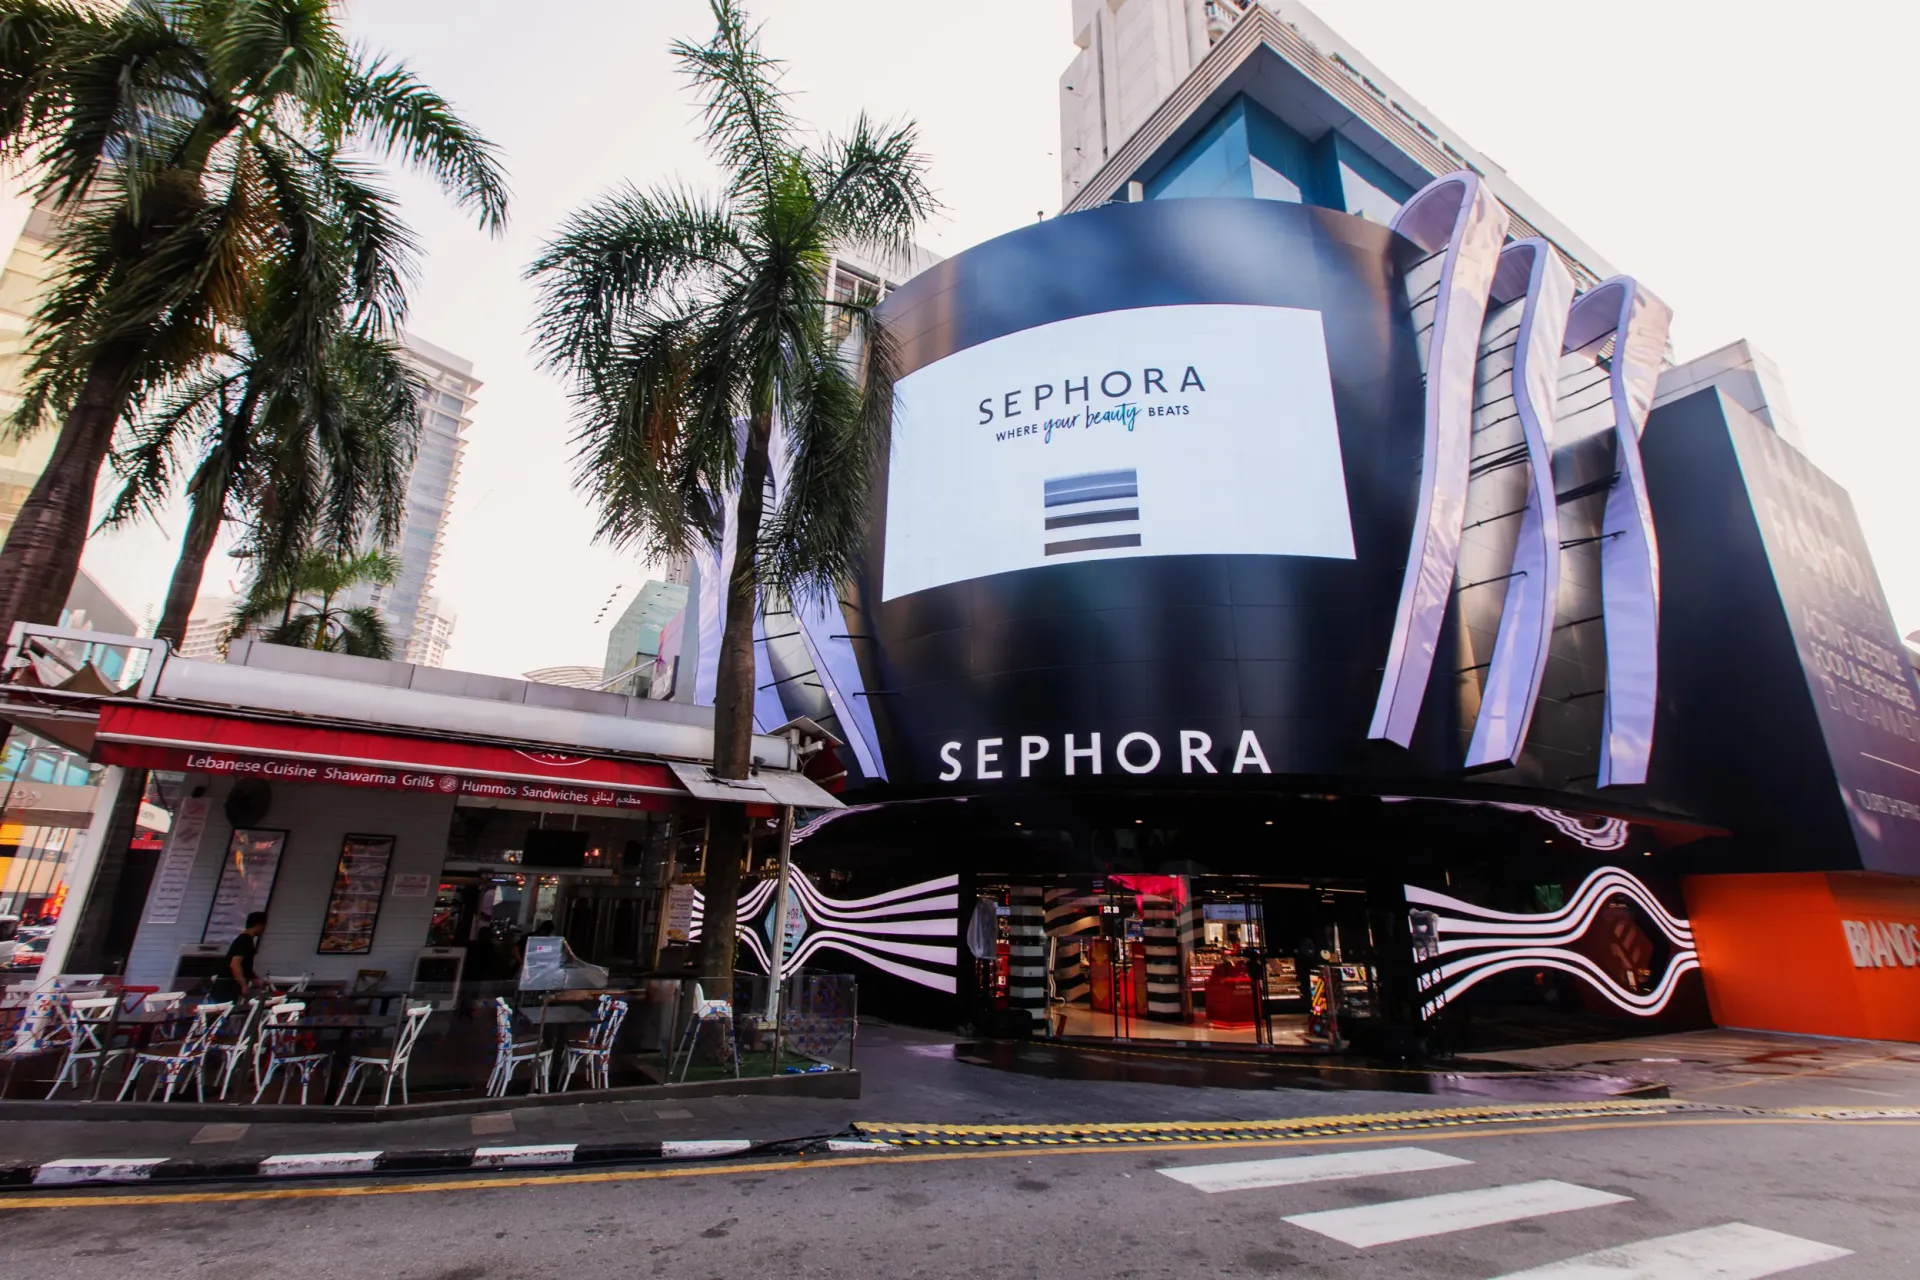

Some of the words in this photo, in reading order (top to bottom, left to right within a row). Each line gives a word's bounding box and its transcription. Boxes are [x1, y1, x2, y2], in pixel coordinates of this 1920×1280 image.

[979, 365, 1206, 425] SEPHORA
[995, 423, 1038, 442] WHERE
[1043, 413, 1081, 444] your
[1085, 402, 1142, 432] beauty
[1148, 405, 1190, 417] BEATS
[1764, 497, 1882, 612] FASHION
[1809, 641, 1850, 681] FOOD
[939, 730, 1272, 781] SEPHORA
[186, 755, 261, 772] Lebanese
[263, 762, 317, 777] Cuisine
[324, 767, 396, 784] Shawarma
[402, 775, 435, 788] Grills
[462, 780, 517, 796] Hummos
[522, 786, 588, 802] Sandwiches
[592, 791, 614, 805] لبناني
[615, 795, 641, 807] مطعم
